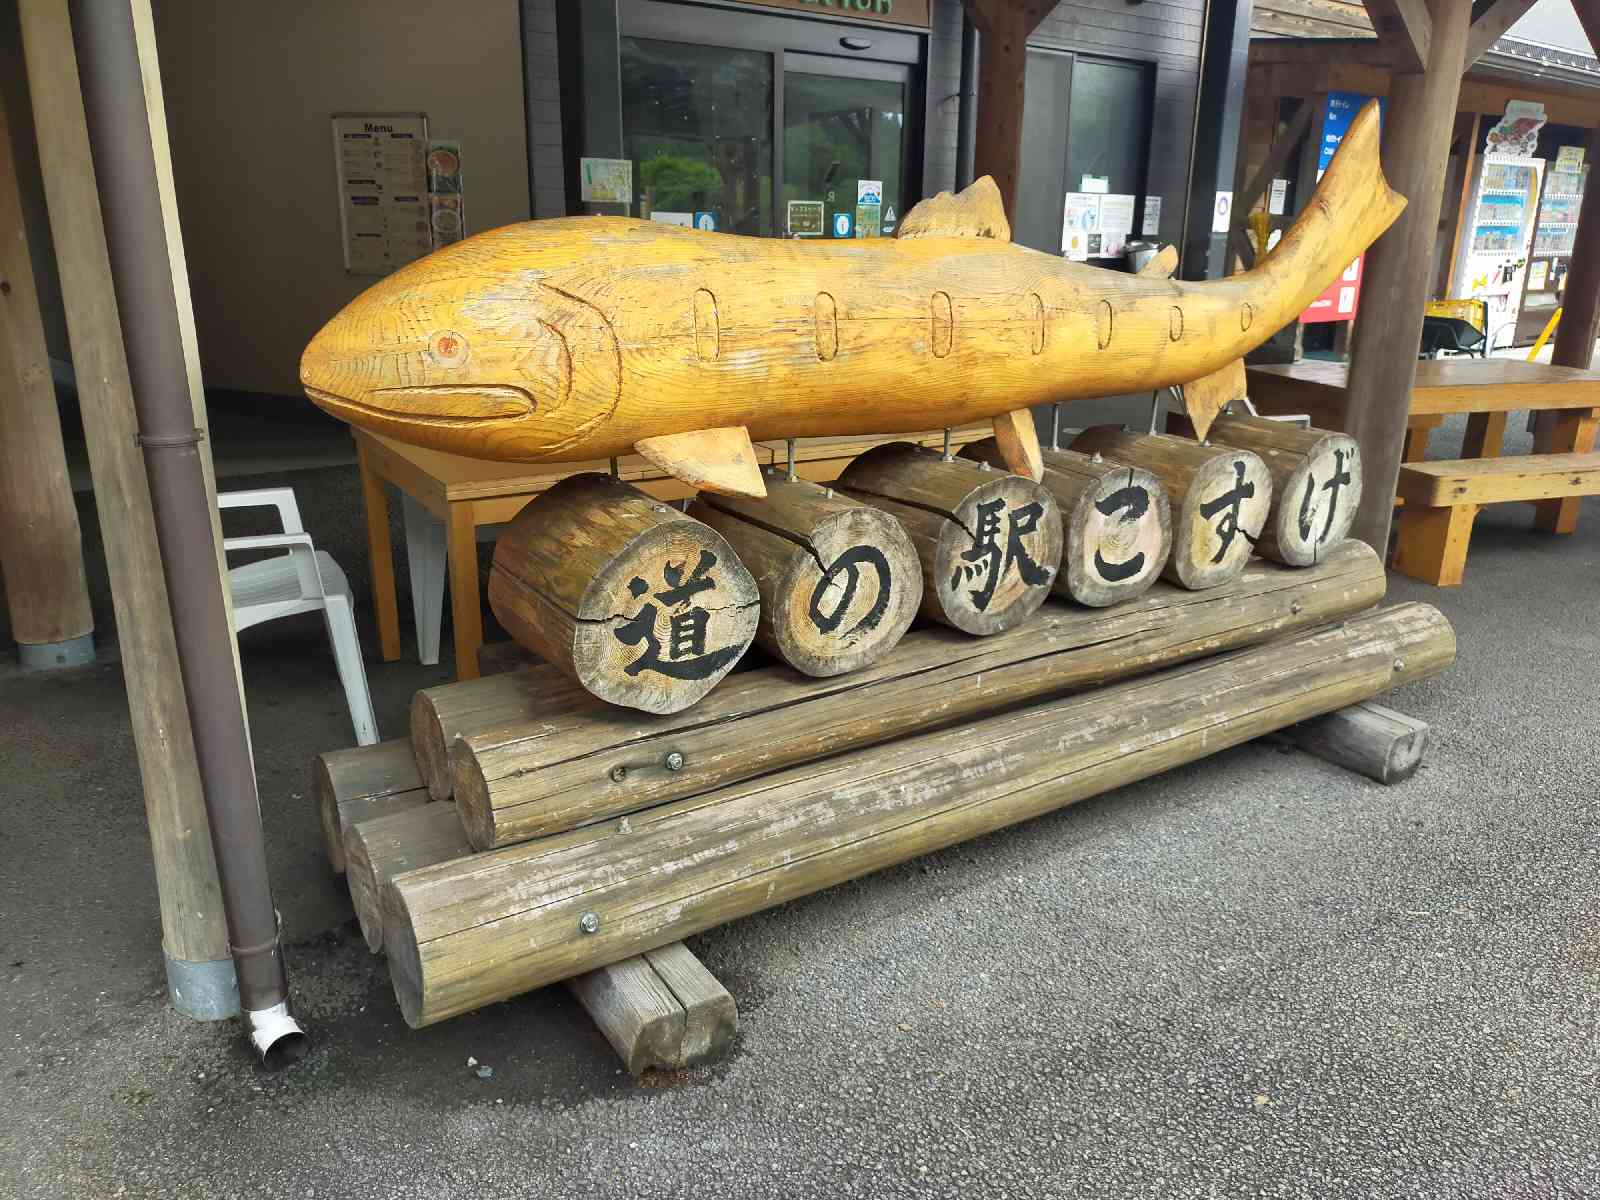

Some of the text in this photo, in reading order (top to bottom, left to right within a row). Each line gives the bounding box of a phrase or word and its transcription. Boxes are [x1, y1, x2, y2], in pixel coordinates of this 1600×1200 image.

[364, 123, 393, 133] Menu
[614, 448, 1356, 681] 道の駅こすげ
